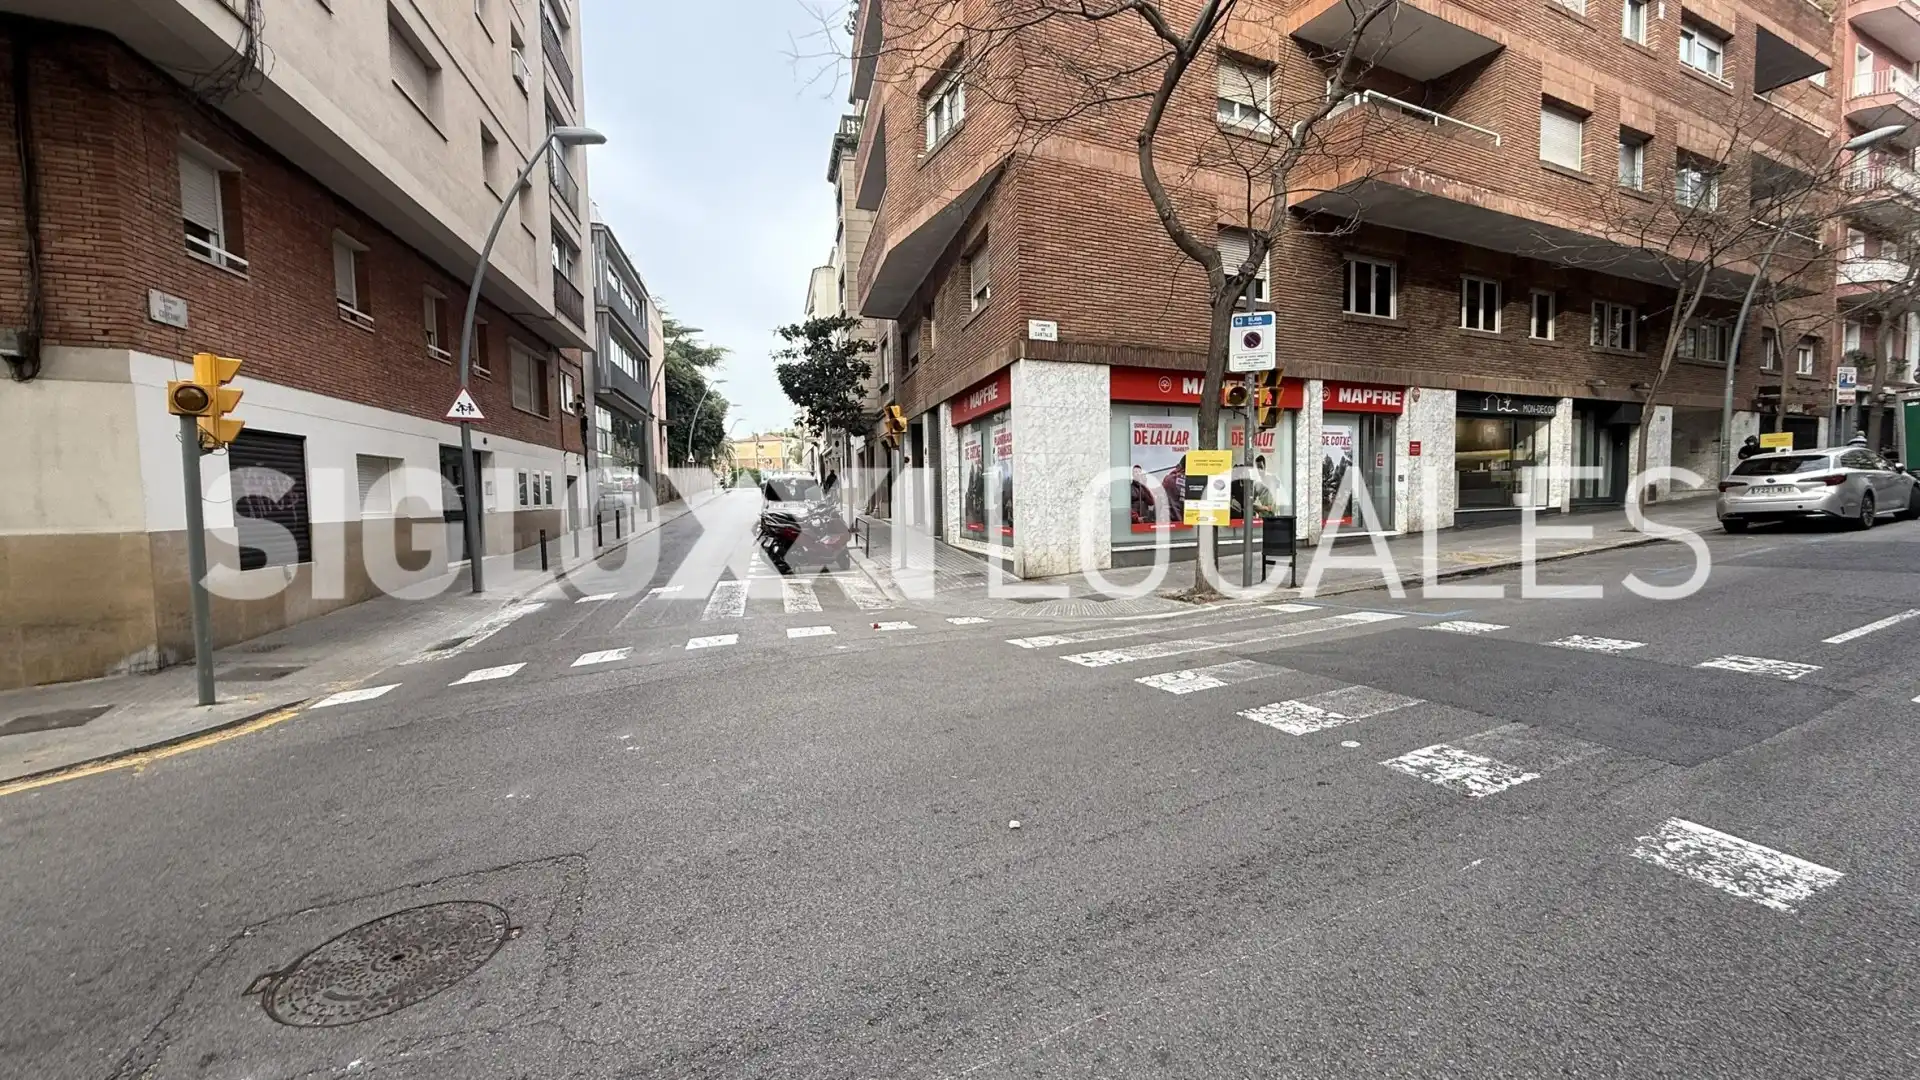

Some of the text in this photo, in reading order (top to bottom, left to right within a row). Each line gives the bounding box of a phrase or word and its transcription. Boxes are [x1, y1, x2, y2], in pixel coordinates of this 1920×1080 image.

[970, 382, 998, 410] MAPFRE
[1338, 387, 1401, 406] MAPFRE
[1134, 430, 1190, 446] DE LA LLAR
[1231, 431, 1275, 447] DE ALUT
[1330, 436, 1352, 447] COTXE
